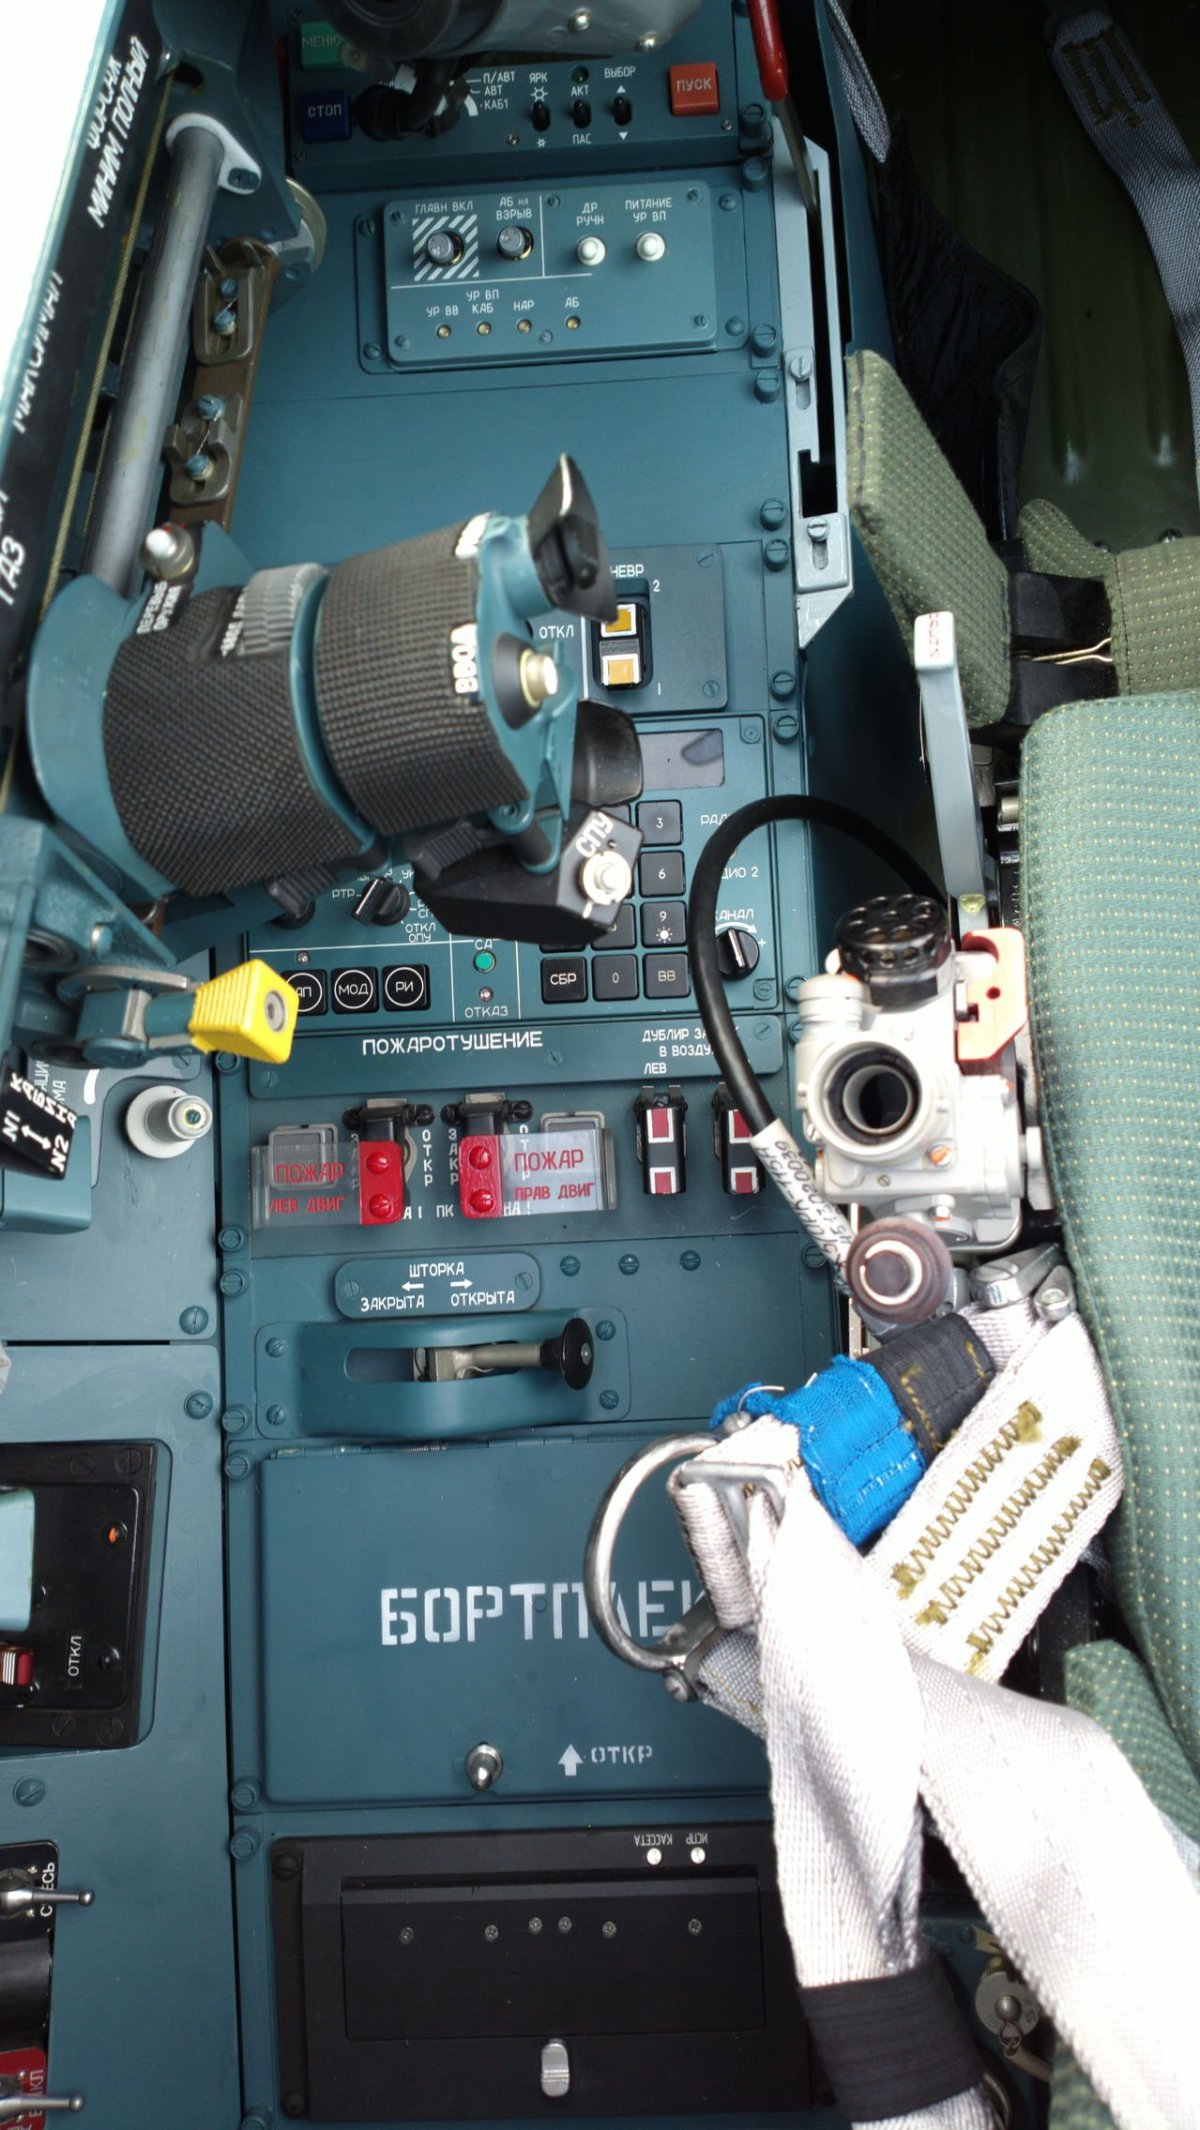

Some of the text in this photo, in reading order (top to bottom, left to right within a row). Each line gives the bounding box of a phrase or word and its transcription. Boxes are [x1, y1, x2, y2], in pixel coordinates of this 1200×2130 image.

[302, 34, 343, 48] МЕНЮ
[483, 71, 516, 84] П/АВТ
[529, 72, 548, 83] ЯРК
[604, 66, 636, 79] ВЫБОР
[571, 85, 589, 97] АКТ
[676, 77, 712, 92] ПУСК
[484, 86, 503, 97] АВТ
[308, 103, 342, 119] СТОП
[87, 35, 150, 229] МИНИМ ПОЛНЫЙ
[573, 133, 592, 145] ПАС
[415, 200, 474, 213] ГЛАВН ВКЛ
[499, 197, 514, 207] АБ
[582, 202, 597, 214] ДР
[625, 197, 672, 210] ПИТАНИЕ
[496, 208, 532, 220] ВЗРЫВ
[576, 214, 604, 226] РУЧН
[633, 210, 667, 223] УР ВП
[466, 288, 500, 301] УР ВП
[472, 302, 494, 314] КАБ
[513, 300, 534, 312] НАР
[565, 297, 580, 308] АБ
[426, 304, 459, 317] УР ВВ
[653, 580, 661, 592] 2
[539, 625, 574, 639] ОТКЛ
[656, 817, 664, 829] 3
[575, 811, 614, 858] СПУ
[658, 868, 666, 879] 6
[751, 866, 759, 878] 2
[332, 889, 355, 900] РТР
[659, 911, 667, 922] 9
[715, 909, 754, 921] АНАЛ
[405, 922, 436, 934] ОТКЛ
[409, 932, 431, 944] ОПУ
[475, 938, 493, 950] СА
[550, 973, 577, 985] СБР
[658, 970, 675, 982] ВВ
[338, 983, 369, 996] МОД
[395, 981, 414, 993] РИ
[464, 1006, 508, 1018] ОТКАЗ
[642, 1028, 689, 1042] ДУБЛИР
[362, 1031, 543, 1056] ПОЖАРОТУШЕНИЕ
[659, 1044, 714, 1057] В ВОЗДУ
[644, 1062, 667, 1075] ЛЕВ
[10, 1072, 78, 1130] КАБИНА
[514, 1148, 584, 1173] ПОЖАР
[274, 1161, 345, 1185] ПОЖАР
[513, 1182, 596, 1202] ПРАВ ДВИГ
[270, 1195, 346, 1214] ЛЕВ ДВИГ
[436, 1204, 454, 1218] ПК
[409, 1262, 465, 1279] ШТОРКА
[360, 1290, 516, 1312] ЗАКРЫТА ОТКРЫТА
[67, 1635, 83, 1679] ОТКЛ
[592, 1746, 653, 1765] ОТКР
[633, 1832, 709, 1847] КАССЕТА ИСПР
[40, 1861, 56, 1918] СЕСЬ
